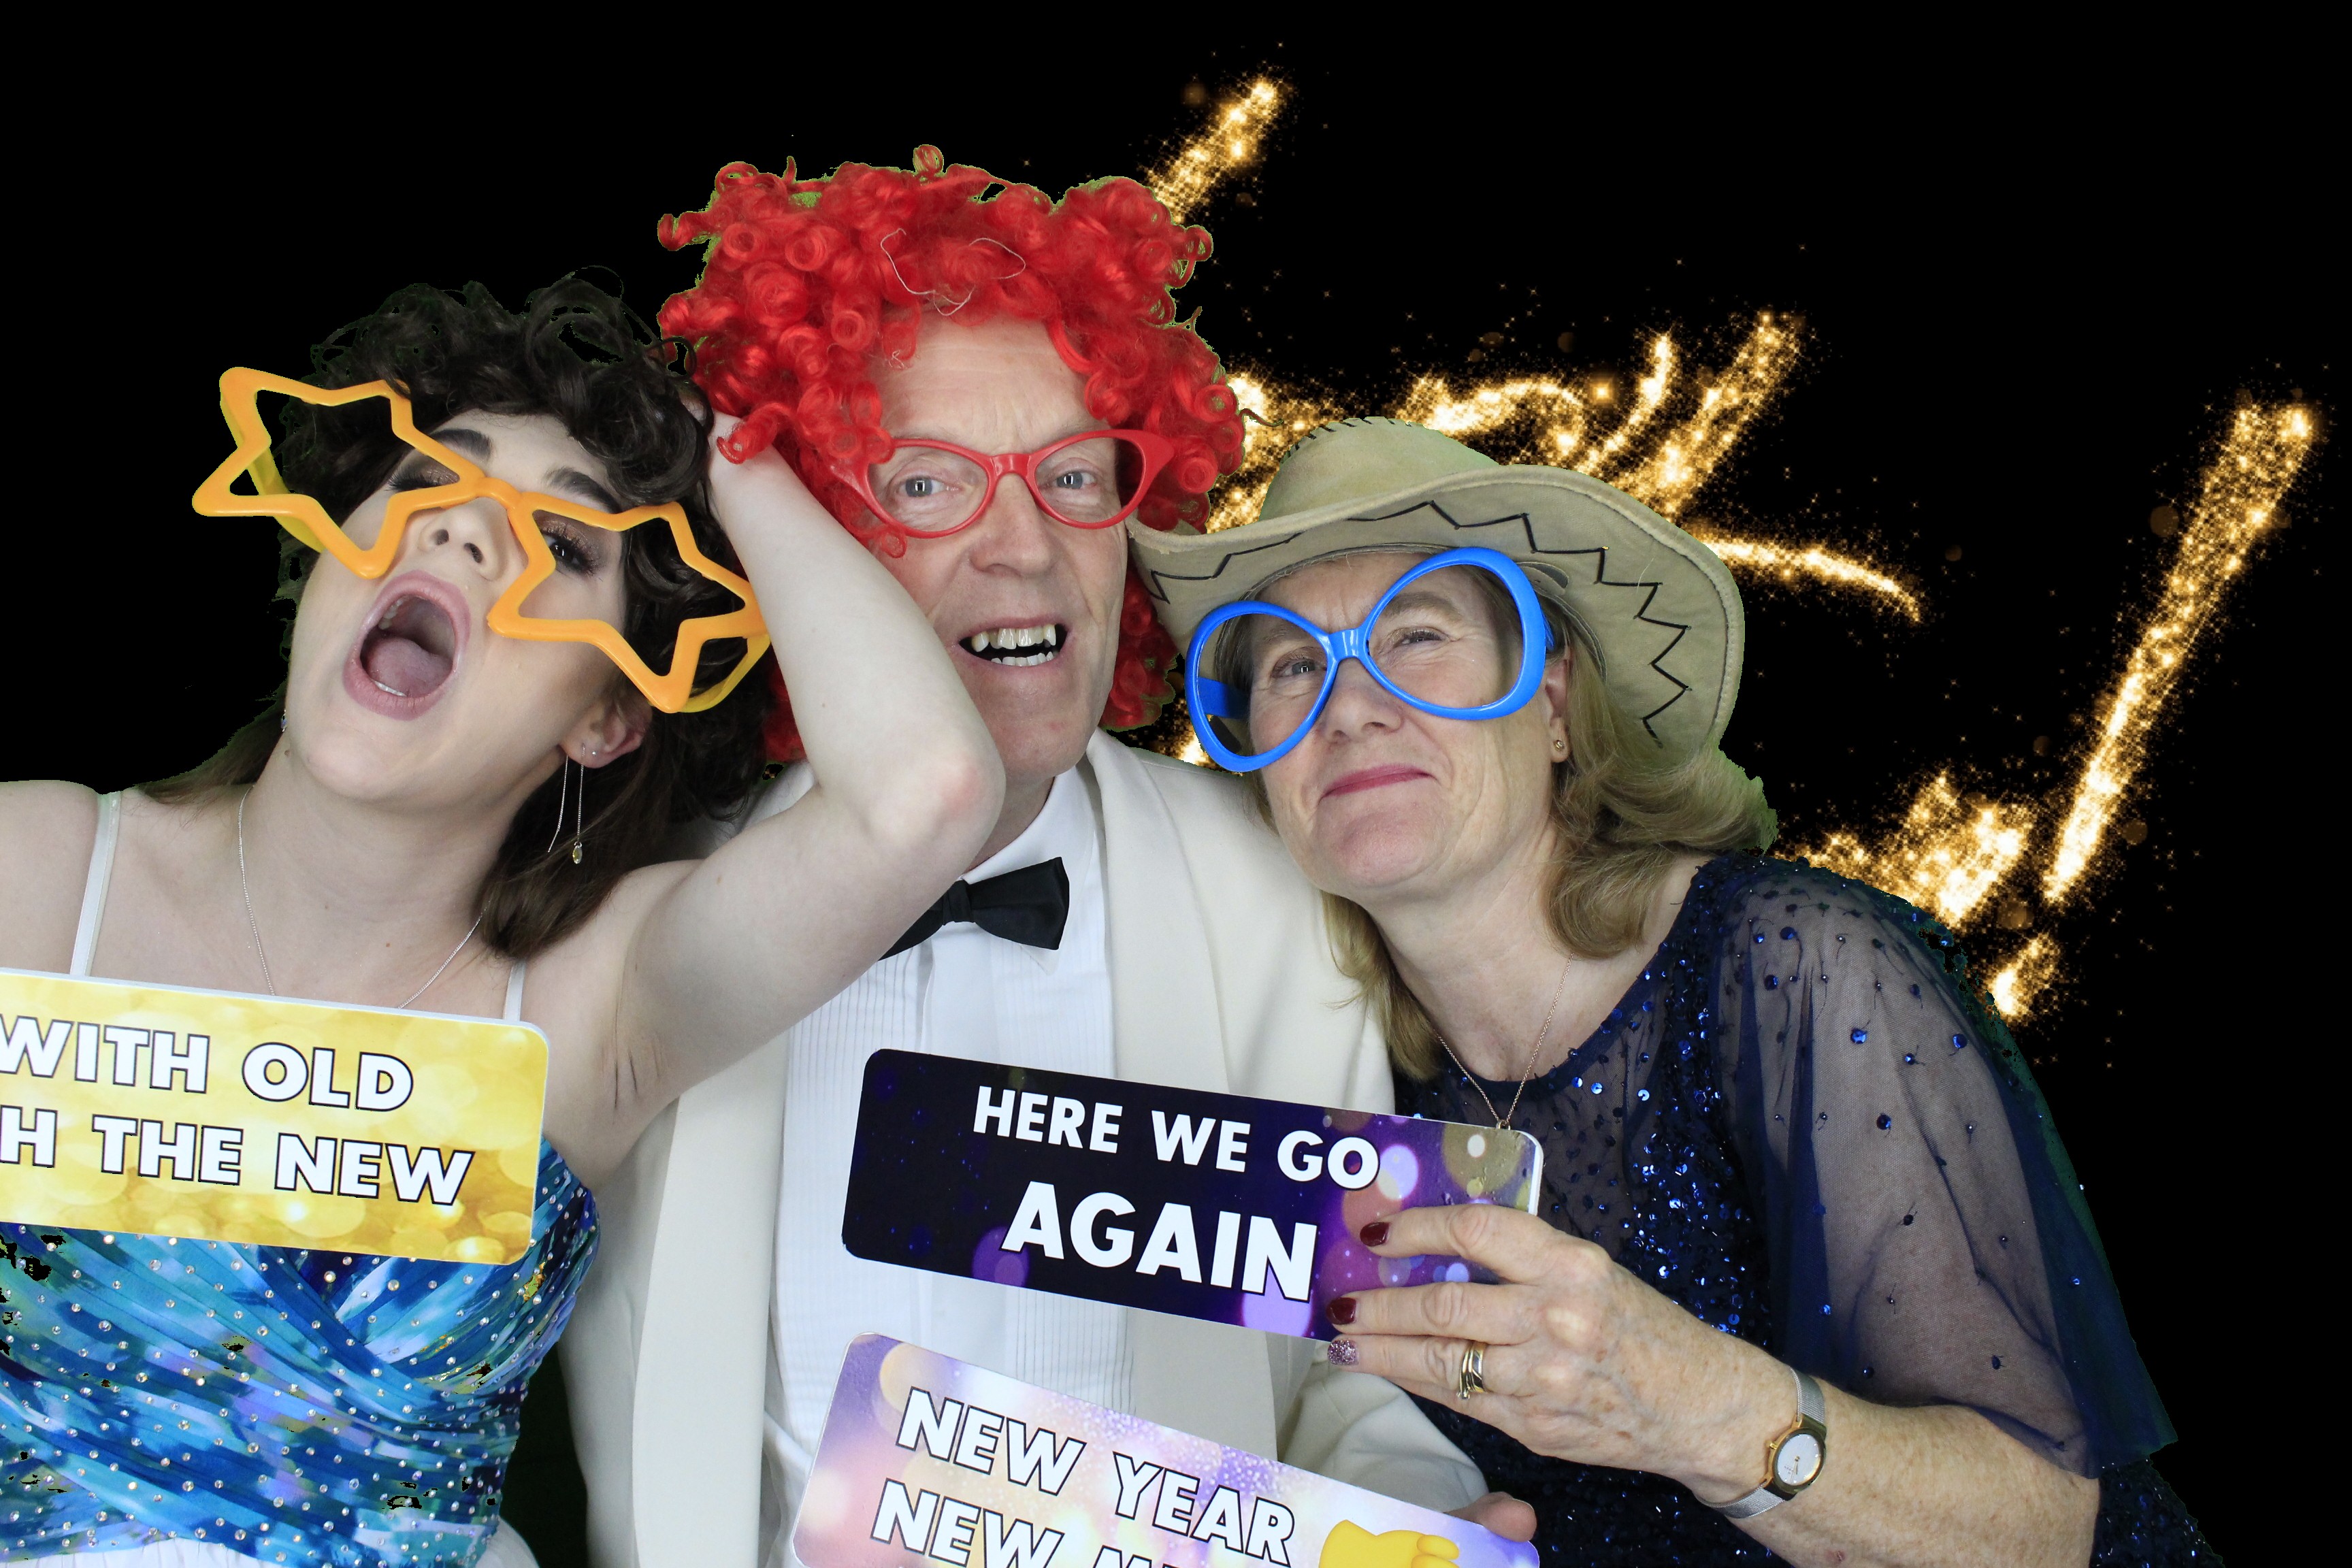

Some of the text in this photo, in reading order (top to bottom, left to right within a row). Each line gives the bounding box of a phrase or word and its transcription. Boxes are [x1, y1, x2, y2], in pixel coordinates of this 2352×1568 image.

[0, 1013, 414, 1111] WITH OLD
[92, 1114, 244, 1186] THE
[274, 1134, 475, 1207] NEW
[973, 1085, 1380, 1190] HERE WE GO
[1000, 1181, 1320, 1303] AGAIN
[870, 1477, 1065, 1568] NEW
[896, 1386, 1294, 1568] NEW YEAR
